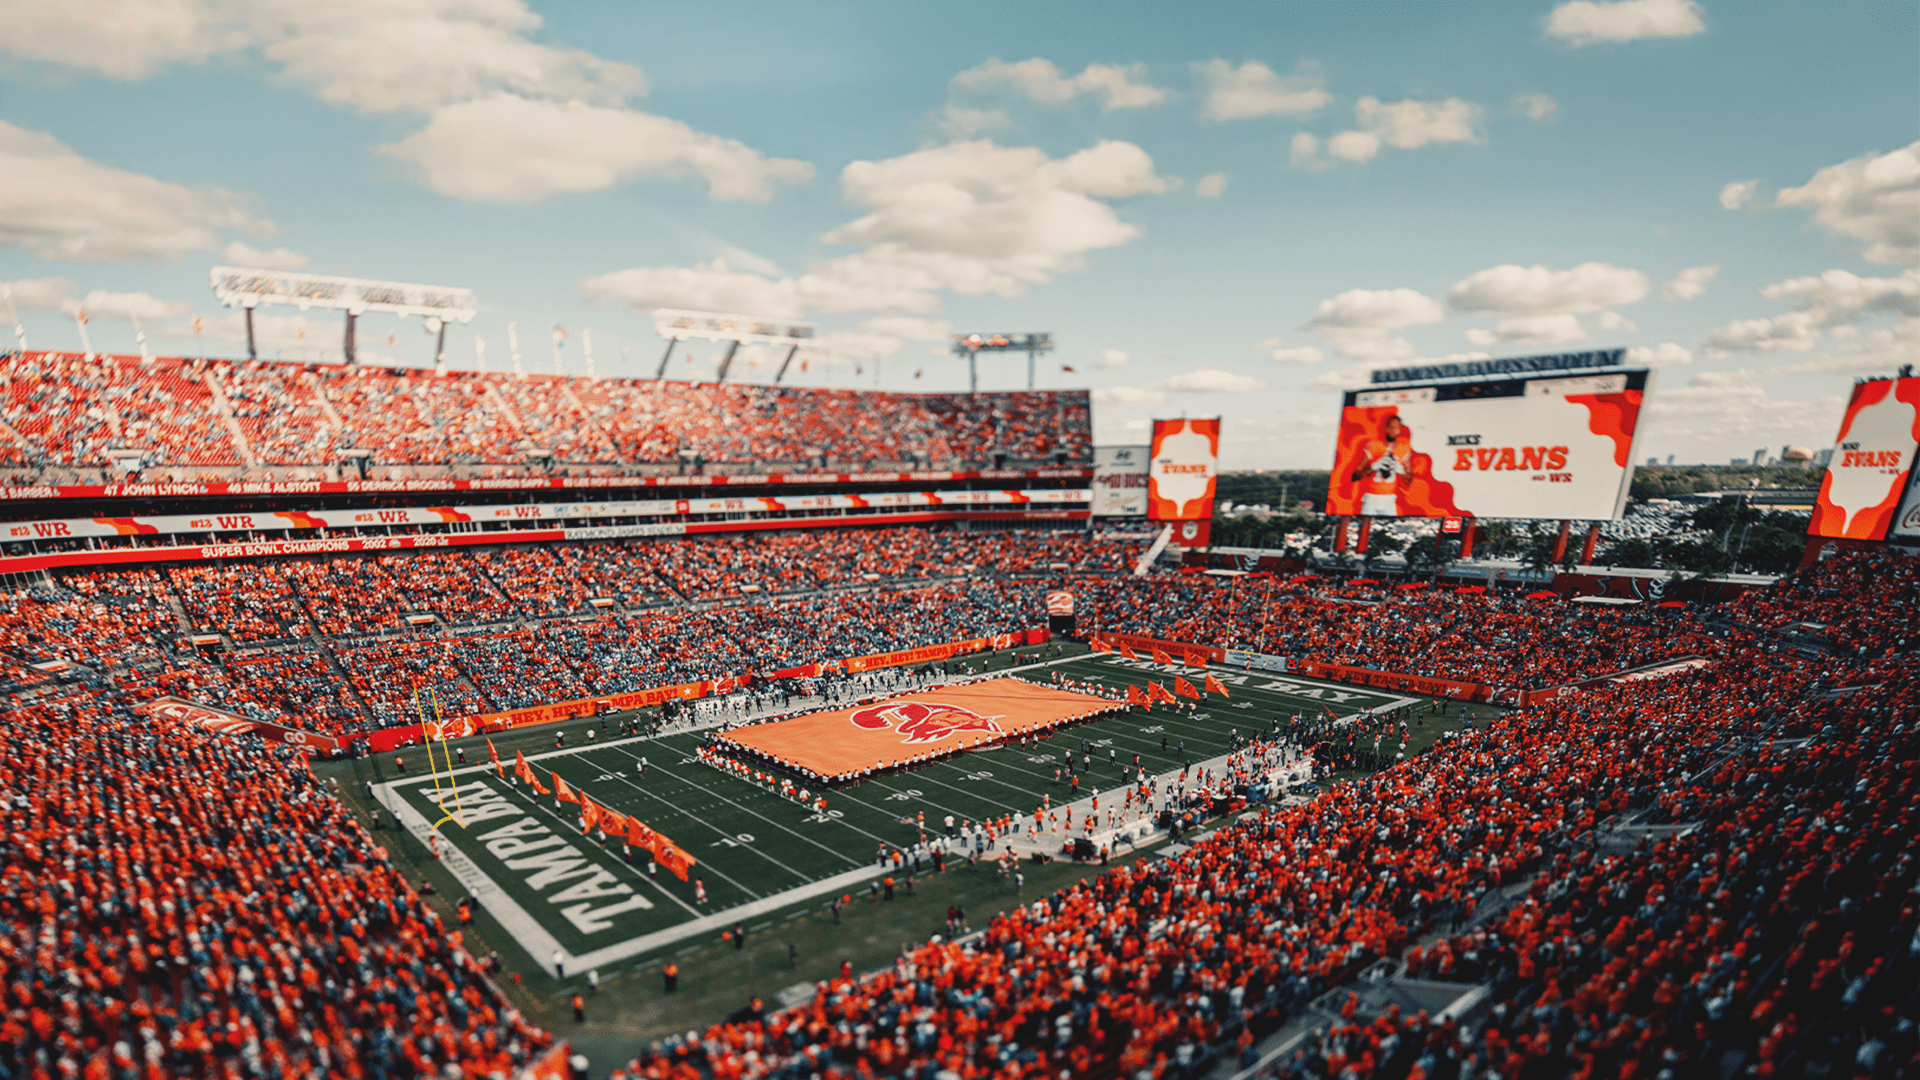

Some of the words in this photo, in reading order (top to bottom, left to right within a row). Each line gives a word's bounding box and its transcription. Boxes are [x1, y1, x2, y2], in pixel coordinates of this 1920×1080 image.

[1452, 446, 1569, 471] EVANS
[1841, 450, 1902, 467] EVANS
[1163, 464, 1207, 474] EVANS
[104, 485, 118, 496] 47
[121, 485, 157, 496] JOHN
[158, 484, 199, 496] LYNCH
[242, 483, 272, 493] MIKE
[273, 482, 321, 493] ALSTOTT
[361, 480, 406, 491] DERRICK
[406, 480, 448, 491] BROOKS
[378, 510, 409, 522] WR
[515, 506, 541, 518] WR
[33, 522, 71, 537] WR
[217, 516, 255, 529] WR
[567, 528, 615, 539] RAYMOND
[201, 546, 243, 558] SUPER
[245, 545, 281, 556] BOWL
[283, 540, 350, 553] CHAMPIONS
[362, 540, 387, 550] 2002
[413, 536, 437, 547] 2020
[891, 652, 914, 663] HEY!
[915, 647, 949, 660] TAMPA
[1373, 674, 1415, 688] TAMA
[1252, 680, 1372, 703] BAY
[1558, 686, 1579, 697] GO
[511, 708, 550, 725] HEY,
[552, 701, 590, 718] HEY!
[646, 688, 678, 703] BAY!
[283, 731, 307, 744] GO
[419, 781, 525, 827] BAY
[809, 809, 845, 824] 20
[720, 833, 756, 848] 10
[476, 817, 655, 935] TAMPA
